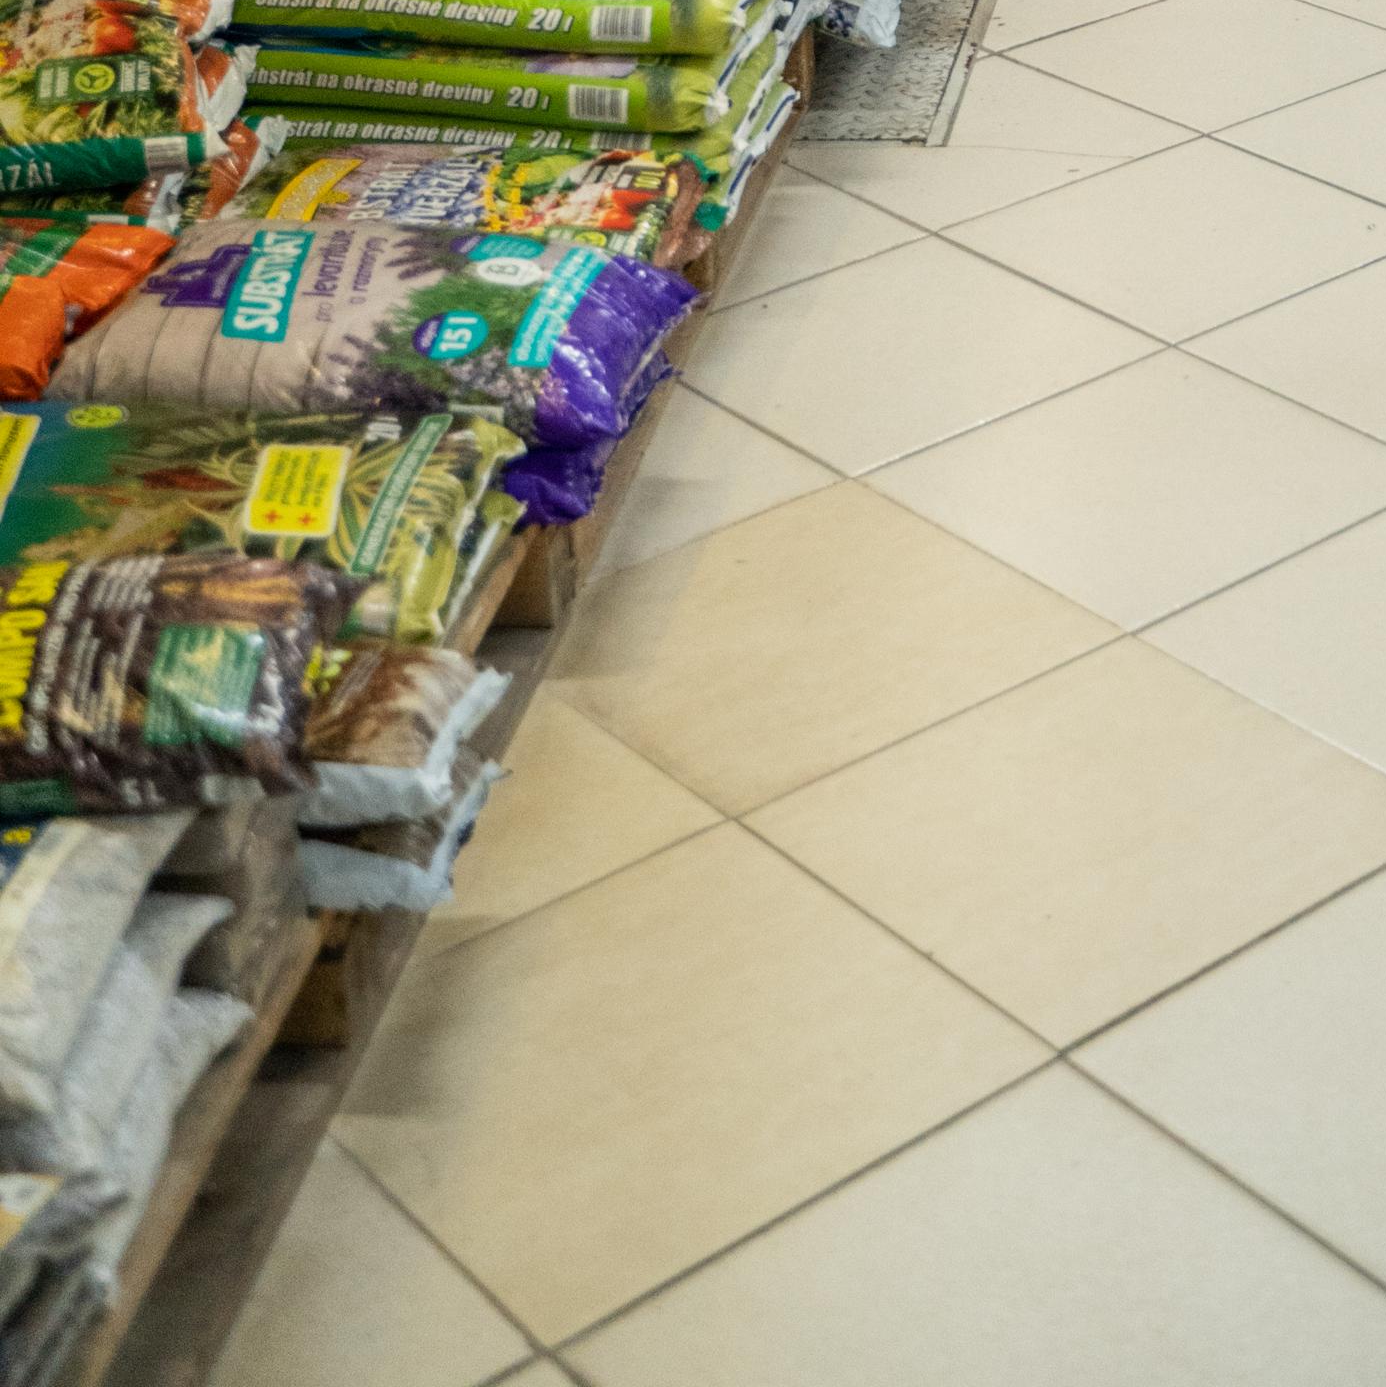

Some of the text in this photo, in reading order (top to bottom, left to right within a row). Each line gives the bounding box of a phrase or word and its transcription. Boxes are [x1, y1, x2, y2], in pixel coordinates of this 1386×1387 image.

[444, 2, 518, 27] dreviny
[527, 7, 563, 31] 20
[317, 72, 339, 89] na
[343, 74, 419, 98] okrasné
[422, 80, 494, 104] dreviny
[506, 85, 540, 108] 20
[332, 122, 357, 140] na
[232, 231, 306, 334] SUBSTRÁT
[440, 328, 473, 354] 15
